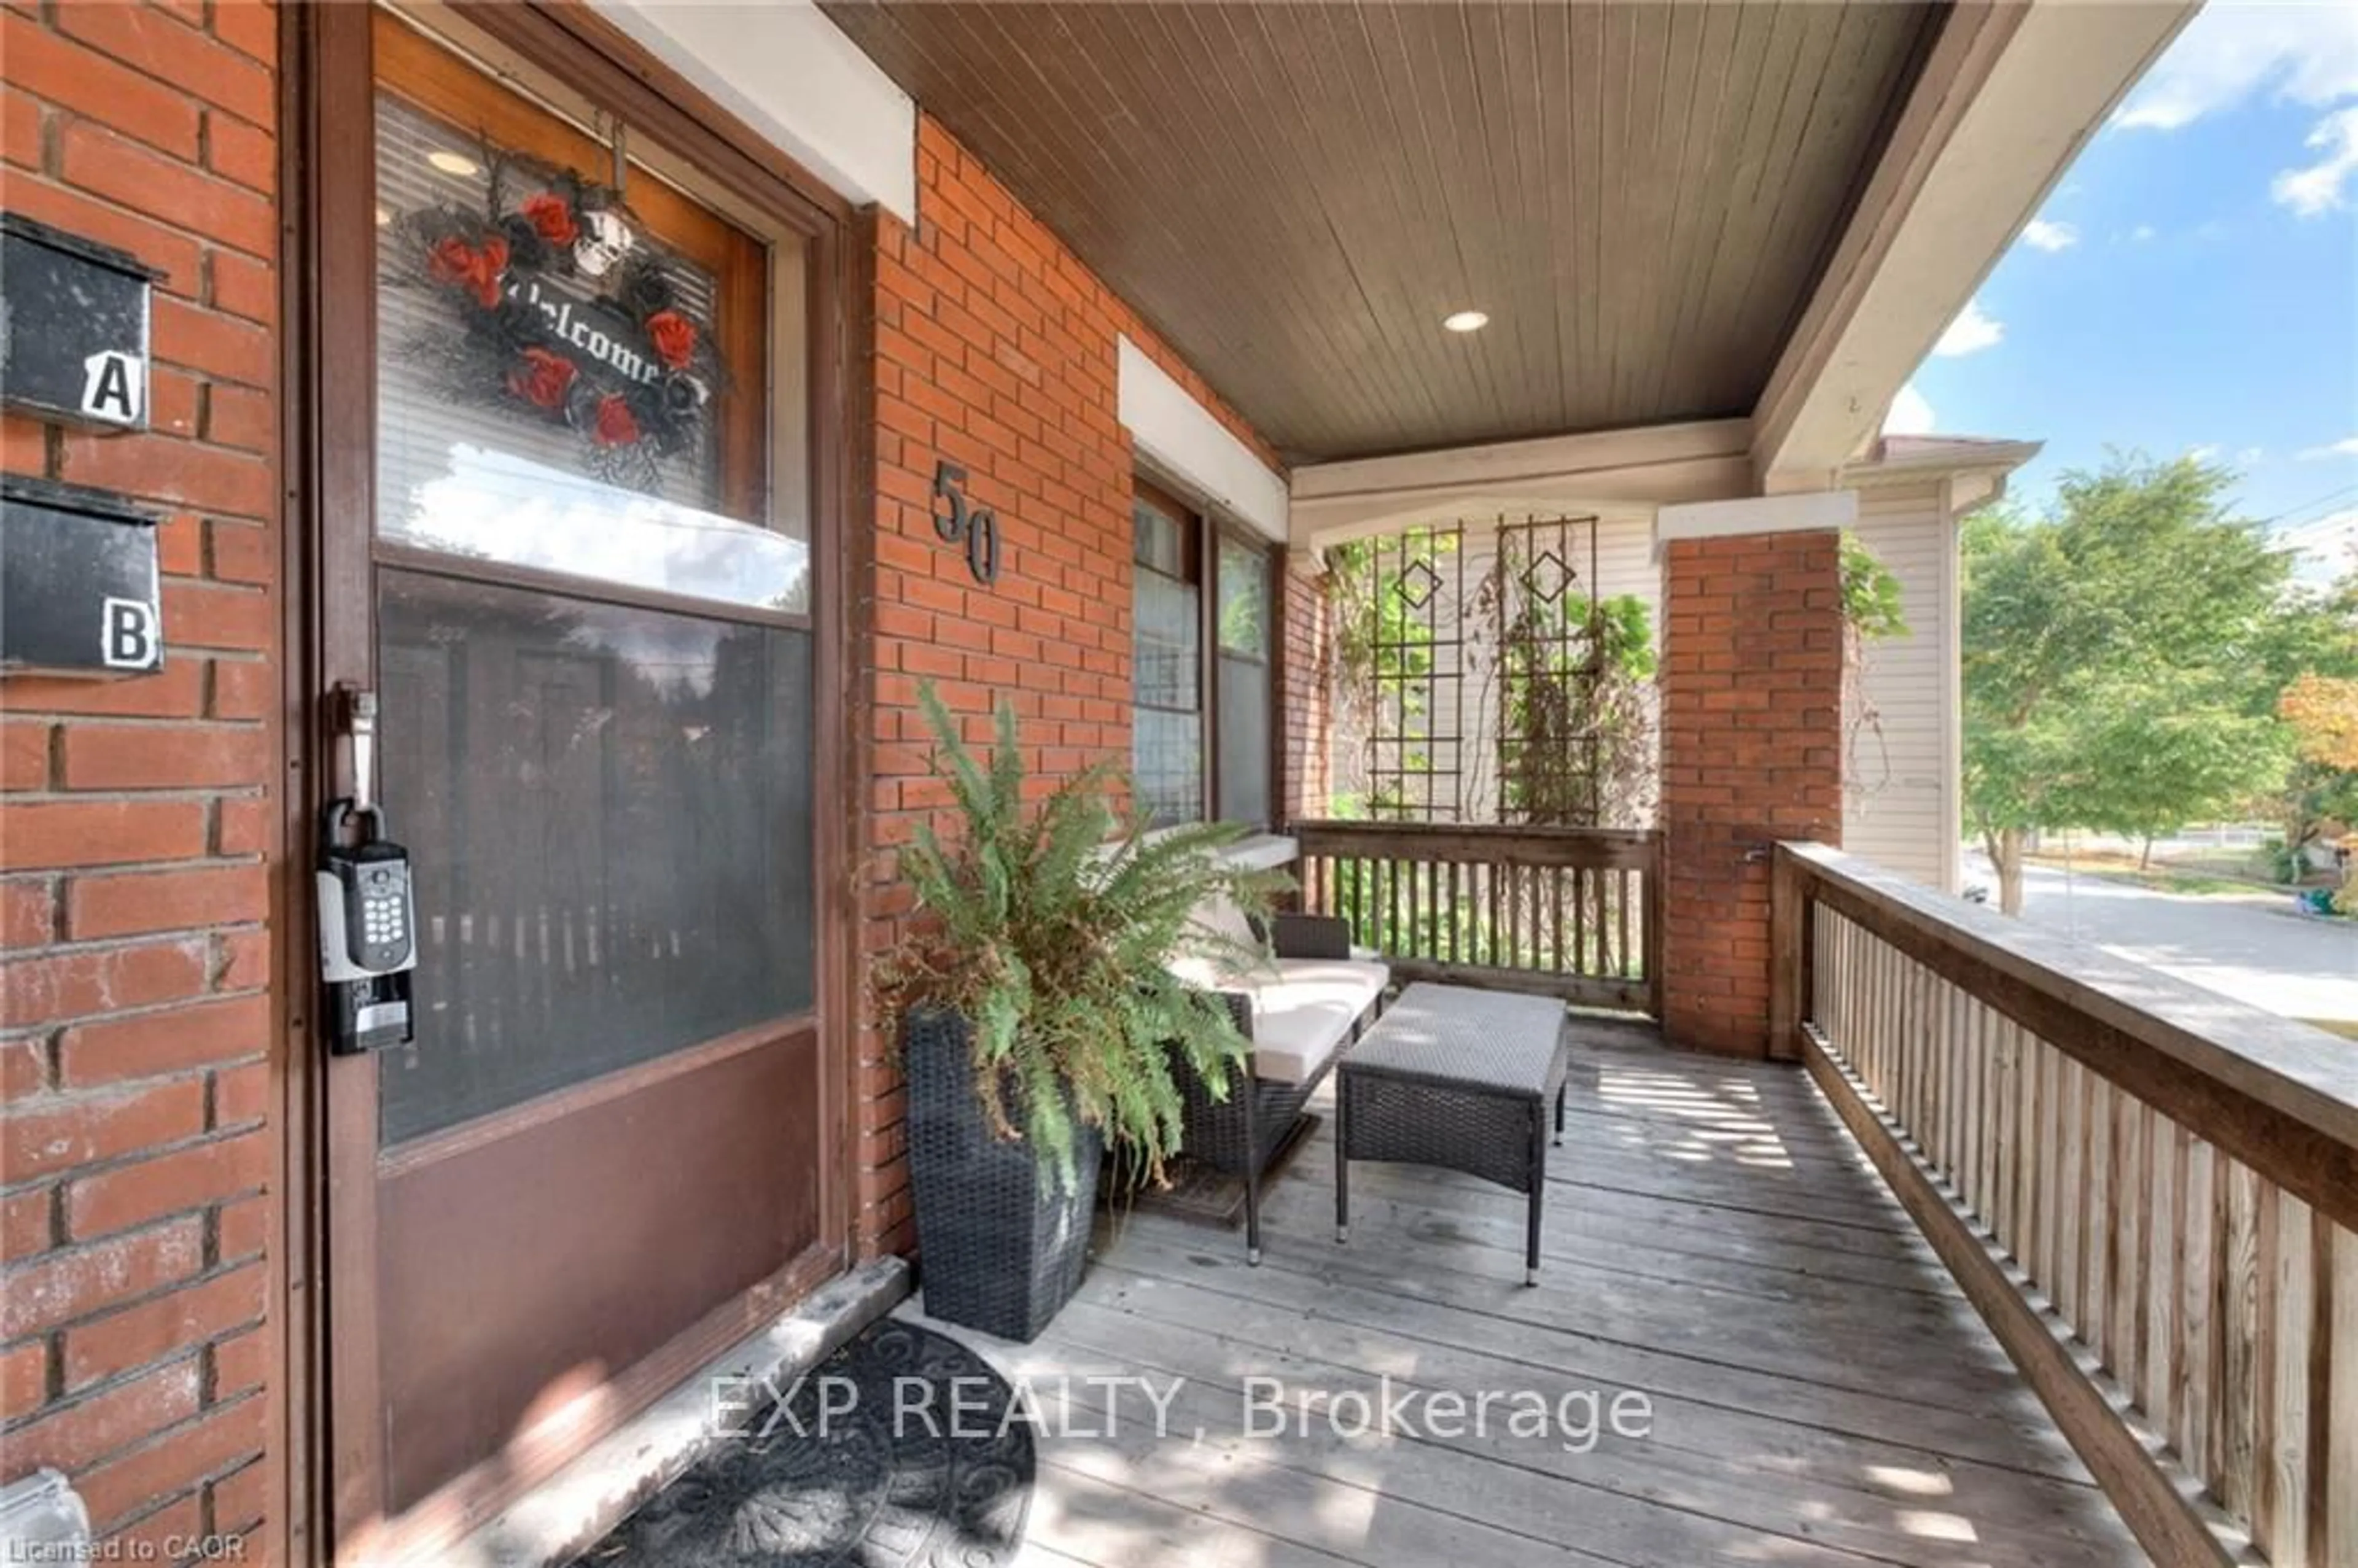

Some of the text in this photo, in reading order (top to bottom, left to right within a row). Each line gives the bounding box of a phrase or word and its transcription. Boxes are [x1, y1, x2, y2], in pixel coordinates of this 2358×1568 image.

[506, 282, 660, 384] elcome
[91, 356, 132, 417] A
[933, 460, 999, 589] 50
[110, 605, 147, 662] B
